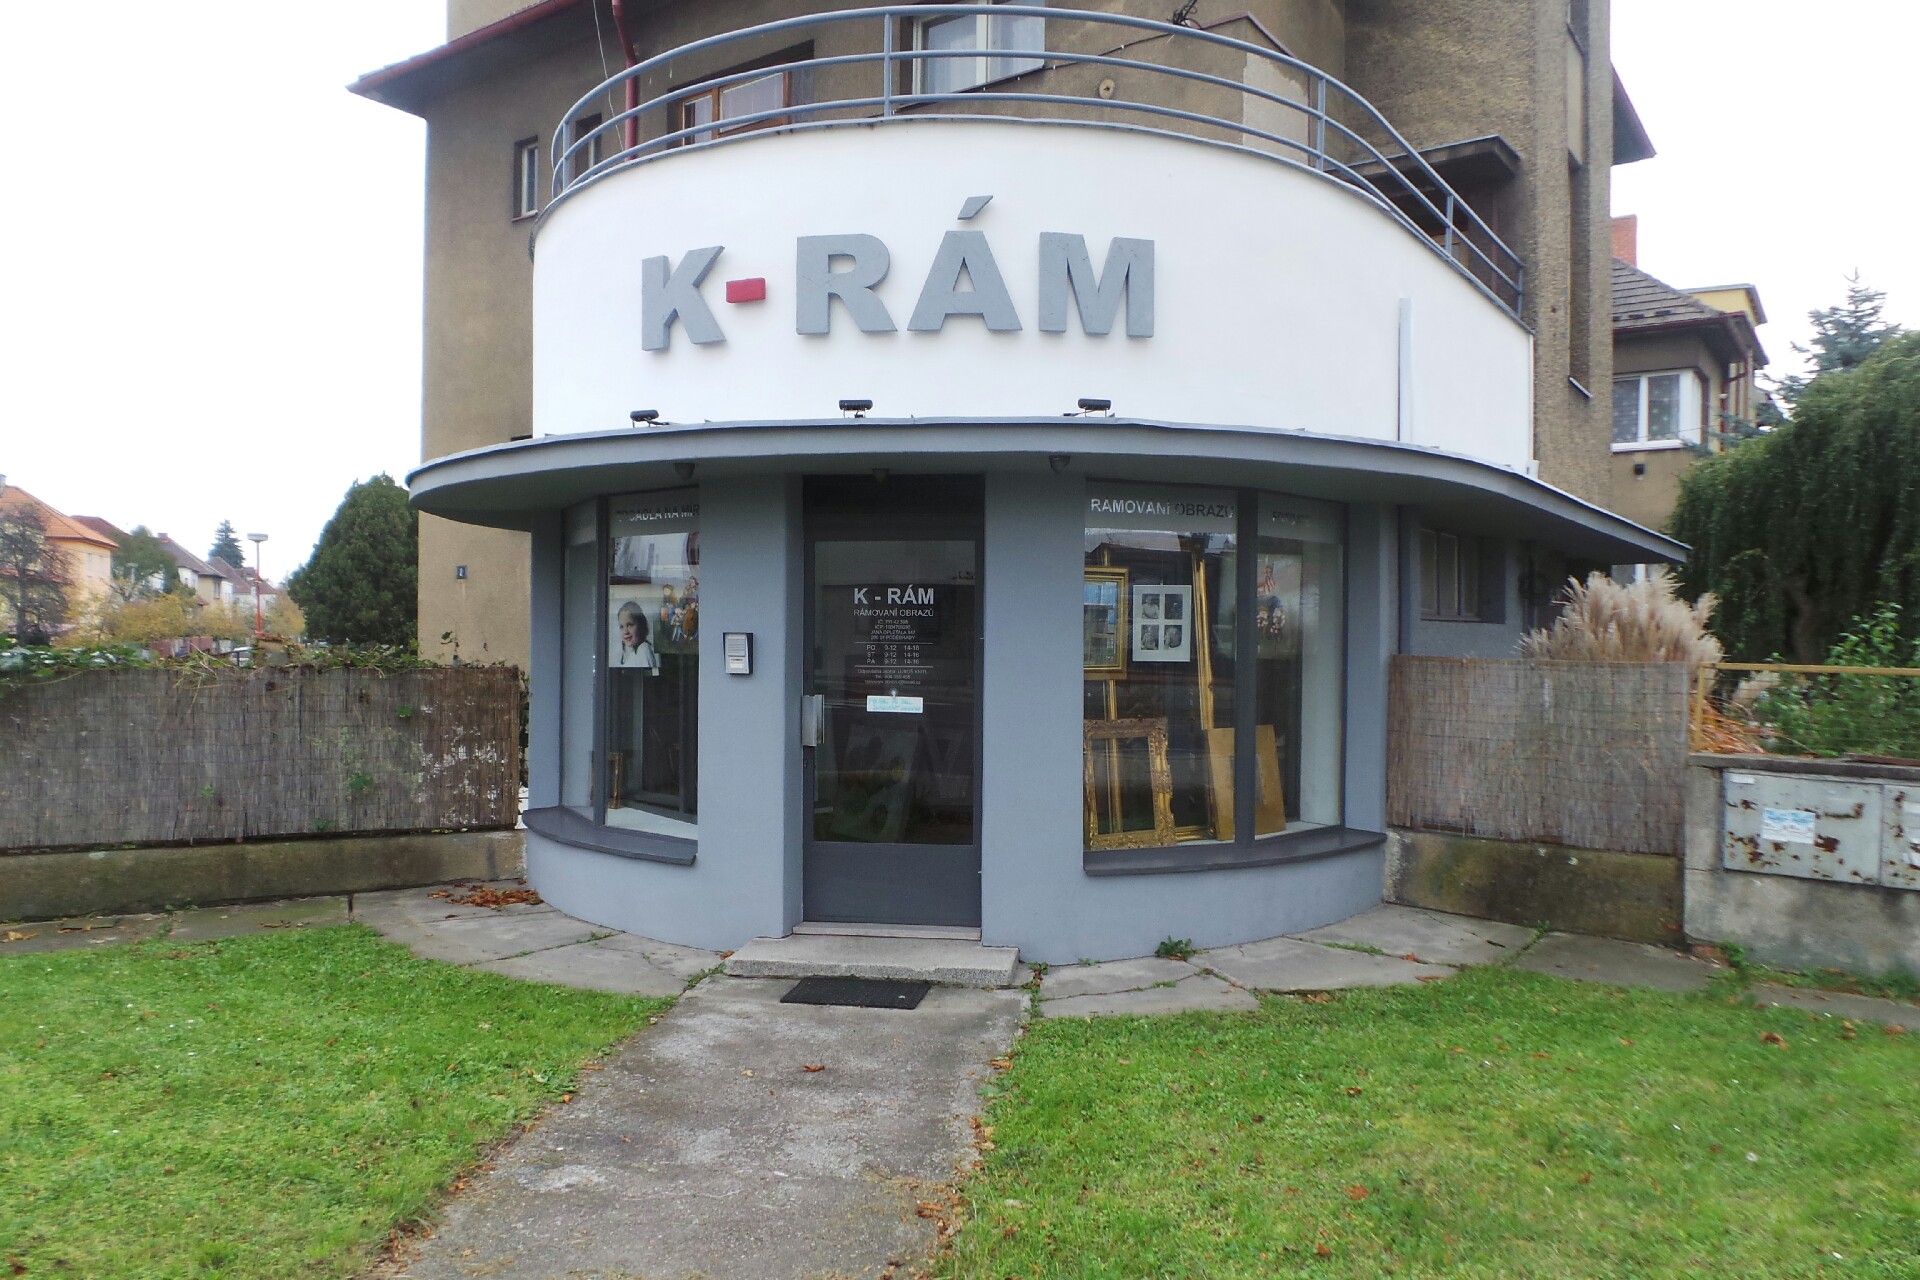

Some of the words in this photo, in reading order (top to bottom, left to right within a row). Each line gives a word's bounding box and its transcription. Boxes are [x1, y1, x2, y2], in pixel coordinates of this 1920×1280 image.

[642, 195, 1155, 351] K-RÁM
[854, 588, 868, 604] K
[887, 584, 934, 604] RÁM
